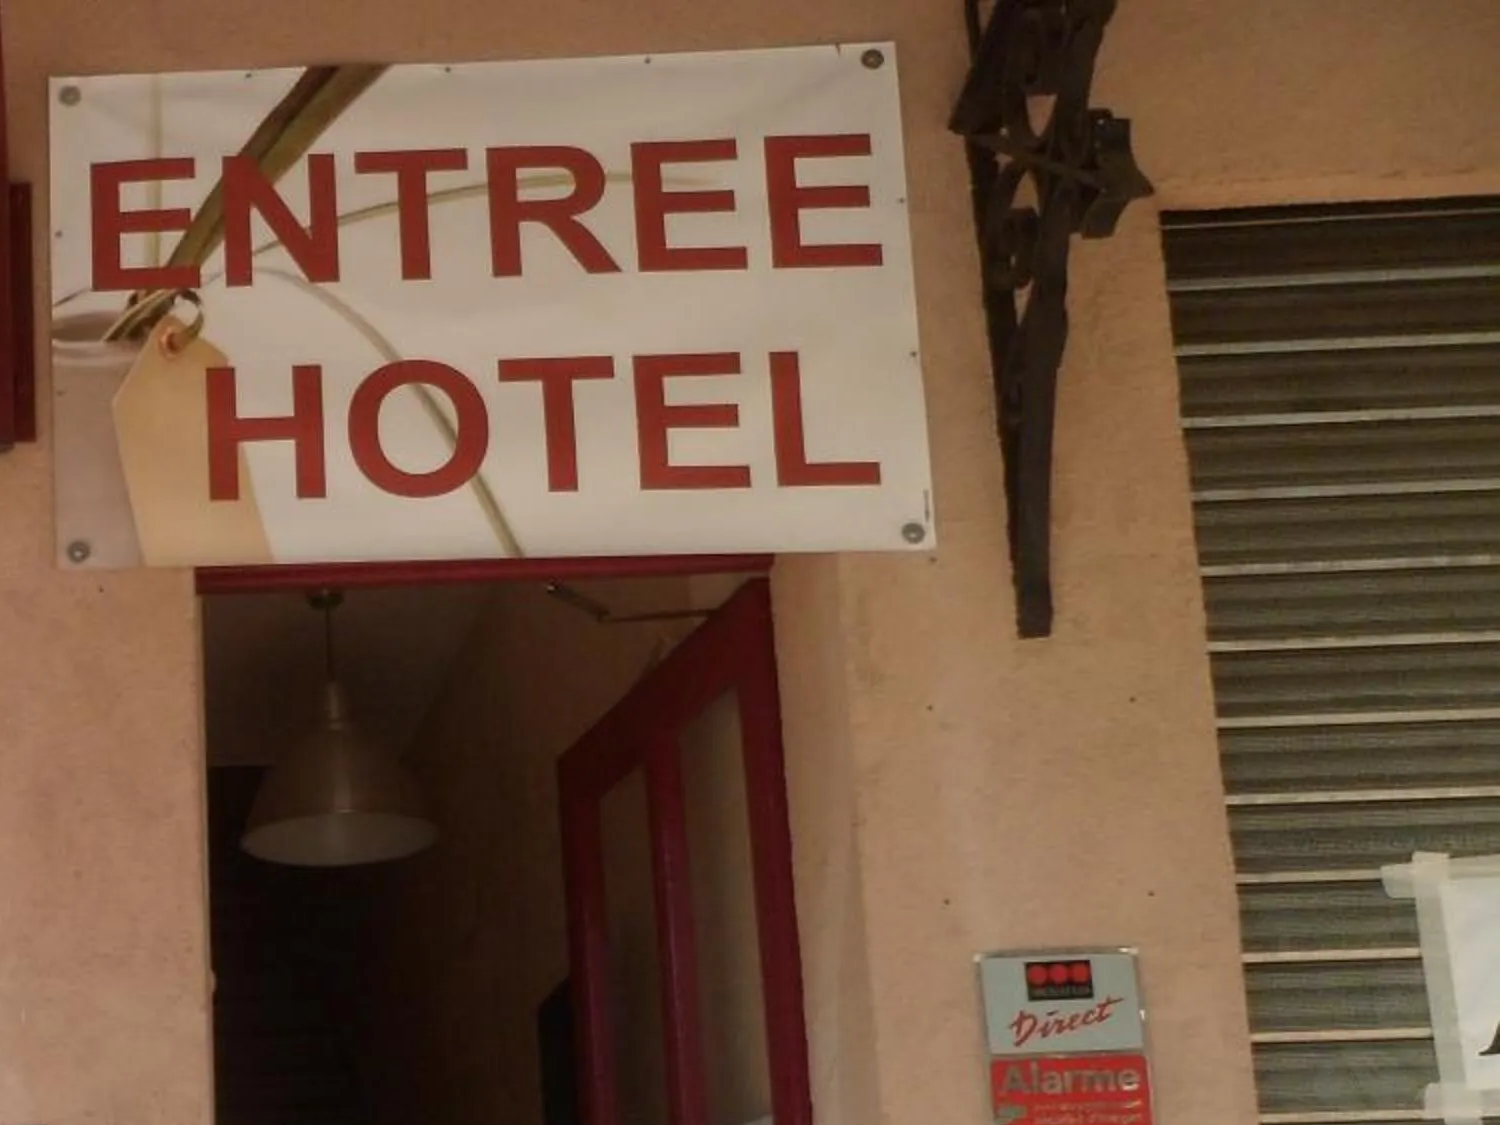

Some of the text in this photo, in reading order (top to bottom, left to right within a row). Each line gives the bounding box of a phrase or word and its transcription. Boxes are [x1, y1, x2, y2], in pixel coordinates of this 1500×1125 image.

[90, 132, 884, 293] ENTREE
[205, 350, 883, 502] HOTEL
[1009, 995, 1124, 1047] Direct
[1003, 1061, 1142, 1095] Alarme
